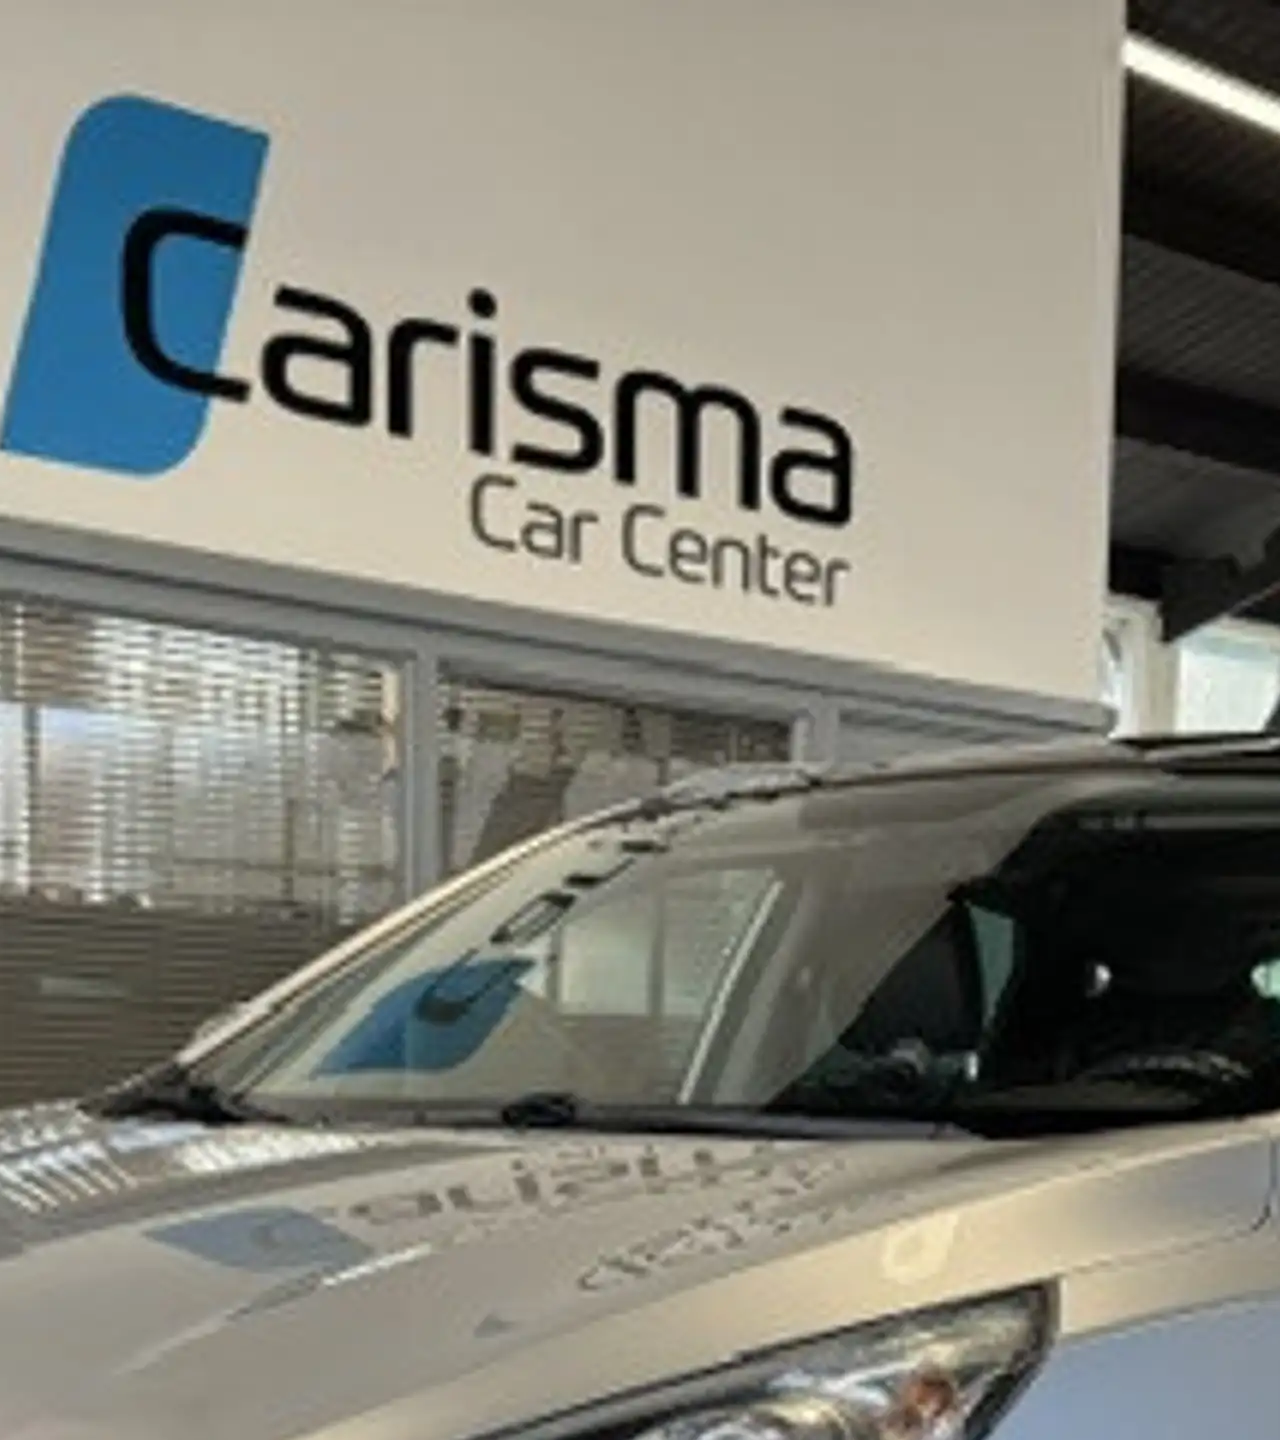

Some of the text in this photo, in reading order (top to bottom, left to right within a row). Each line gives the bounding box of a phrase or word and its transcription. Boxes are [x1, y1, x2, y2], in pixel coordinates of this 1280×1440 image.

[120, 205, 854, 528] Carisma
[468, 472, 852, 607] Car Center
